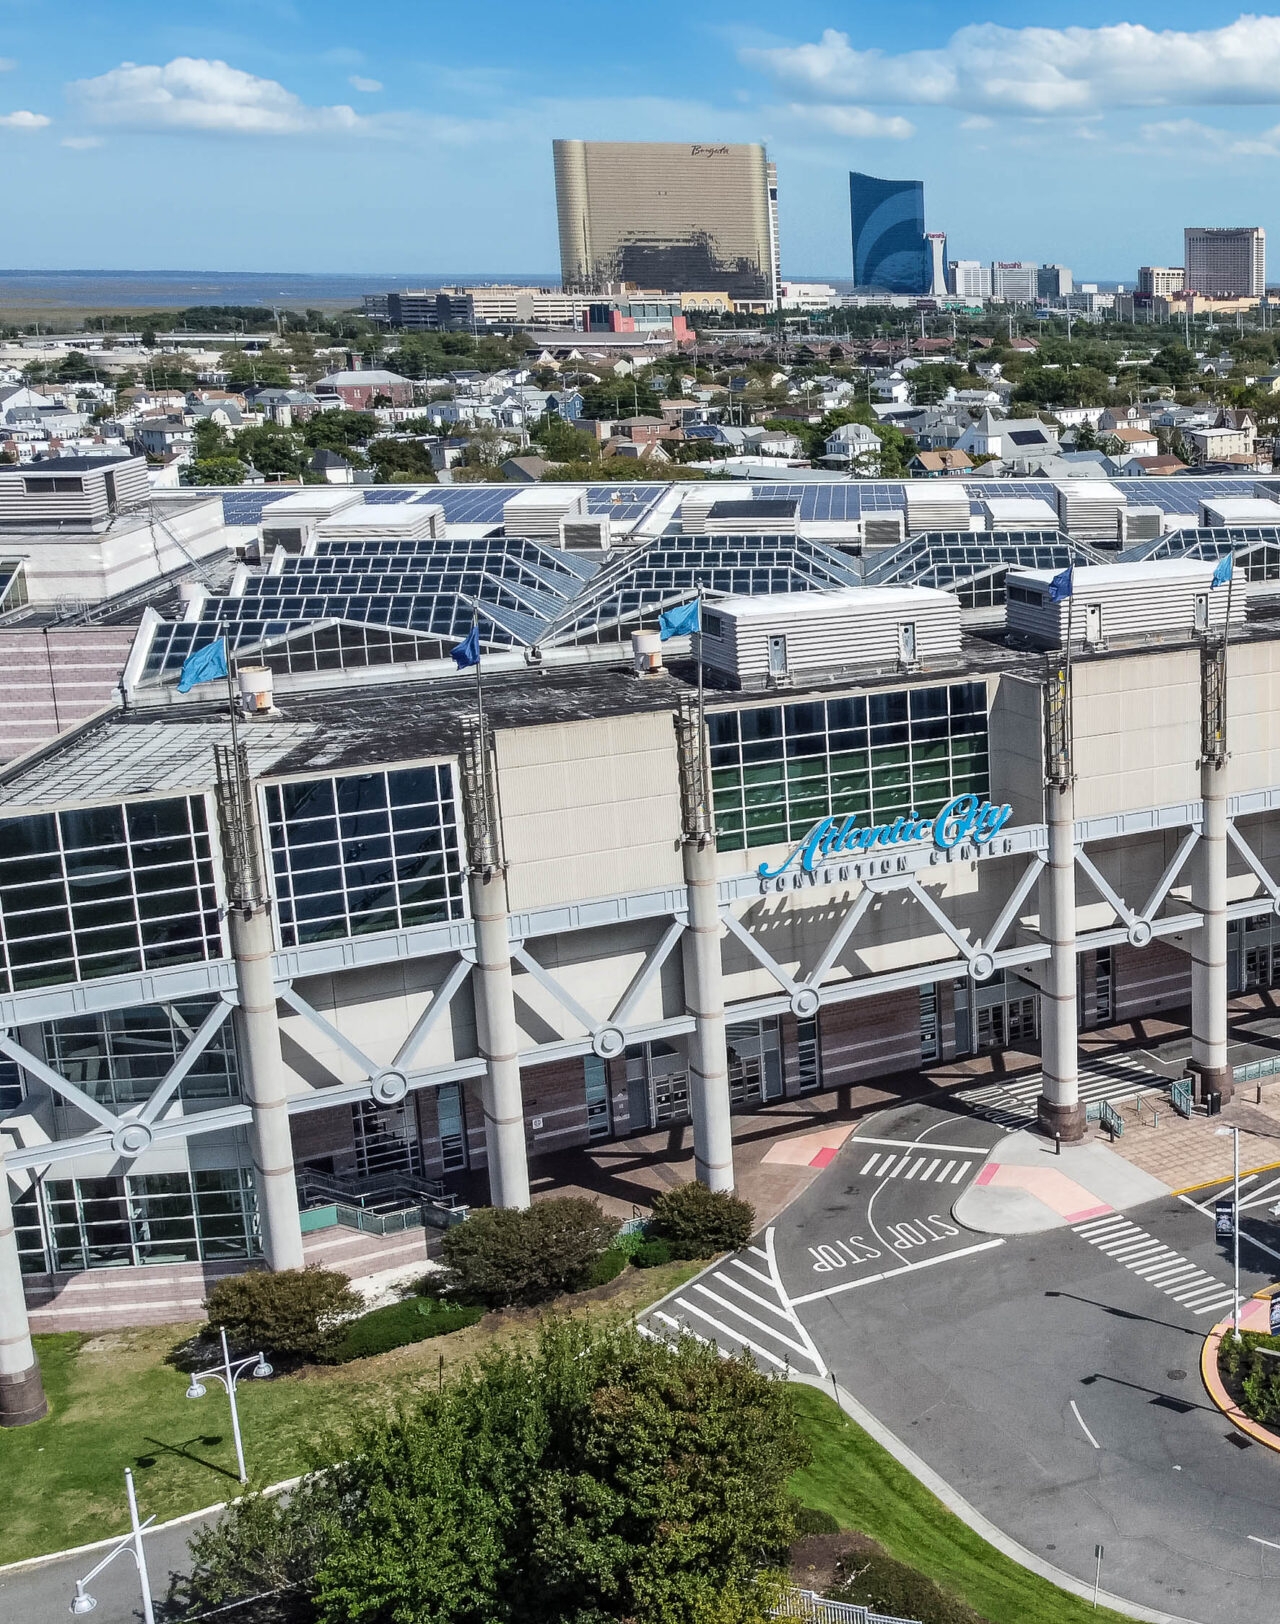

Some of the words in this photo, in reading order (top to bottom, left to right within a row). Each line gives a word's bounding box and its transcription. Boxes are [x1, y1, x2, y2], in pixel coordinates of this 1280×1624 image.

[758, 811, 933, 878] Atlantic
[932, 793, 1014, 849] City
[759, 855, 908, 894] CONVENTION
[929, 838, 1013, 865] CENTER
[807, 1235, 882, 1272] STOP
[886, 1214, 959, 1249] STOP
